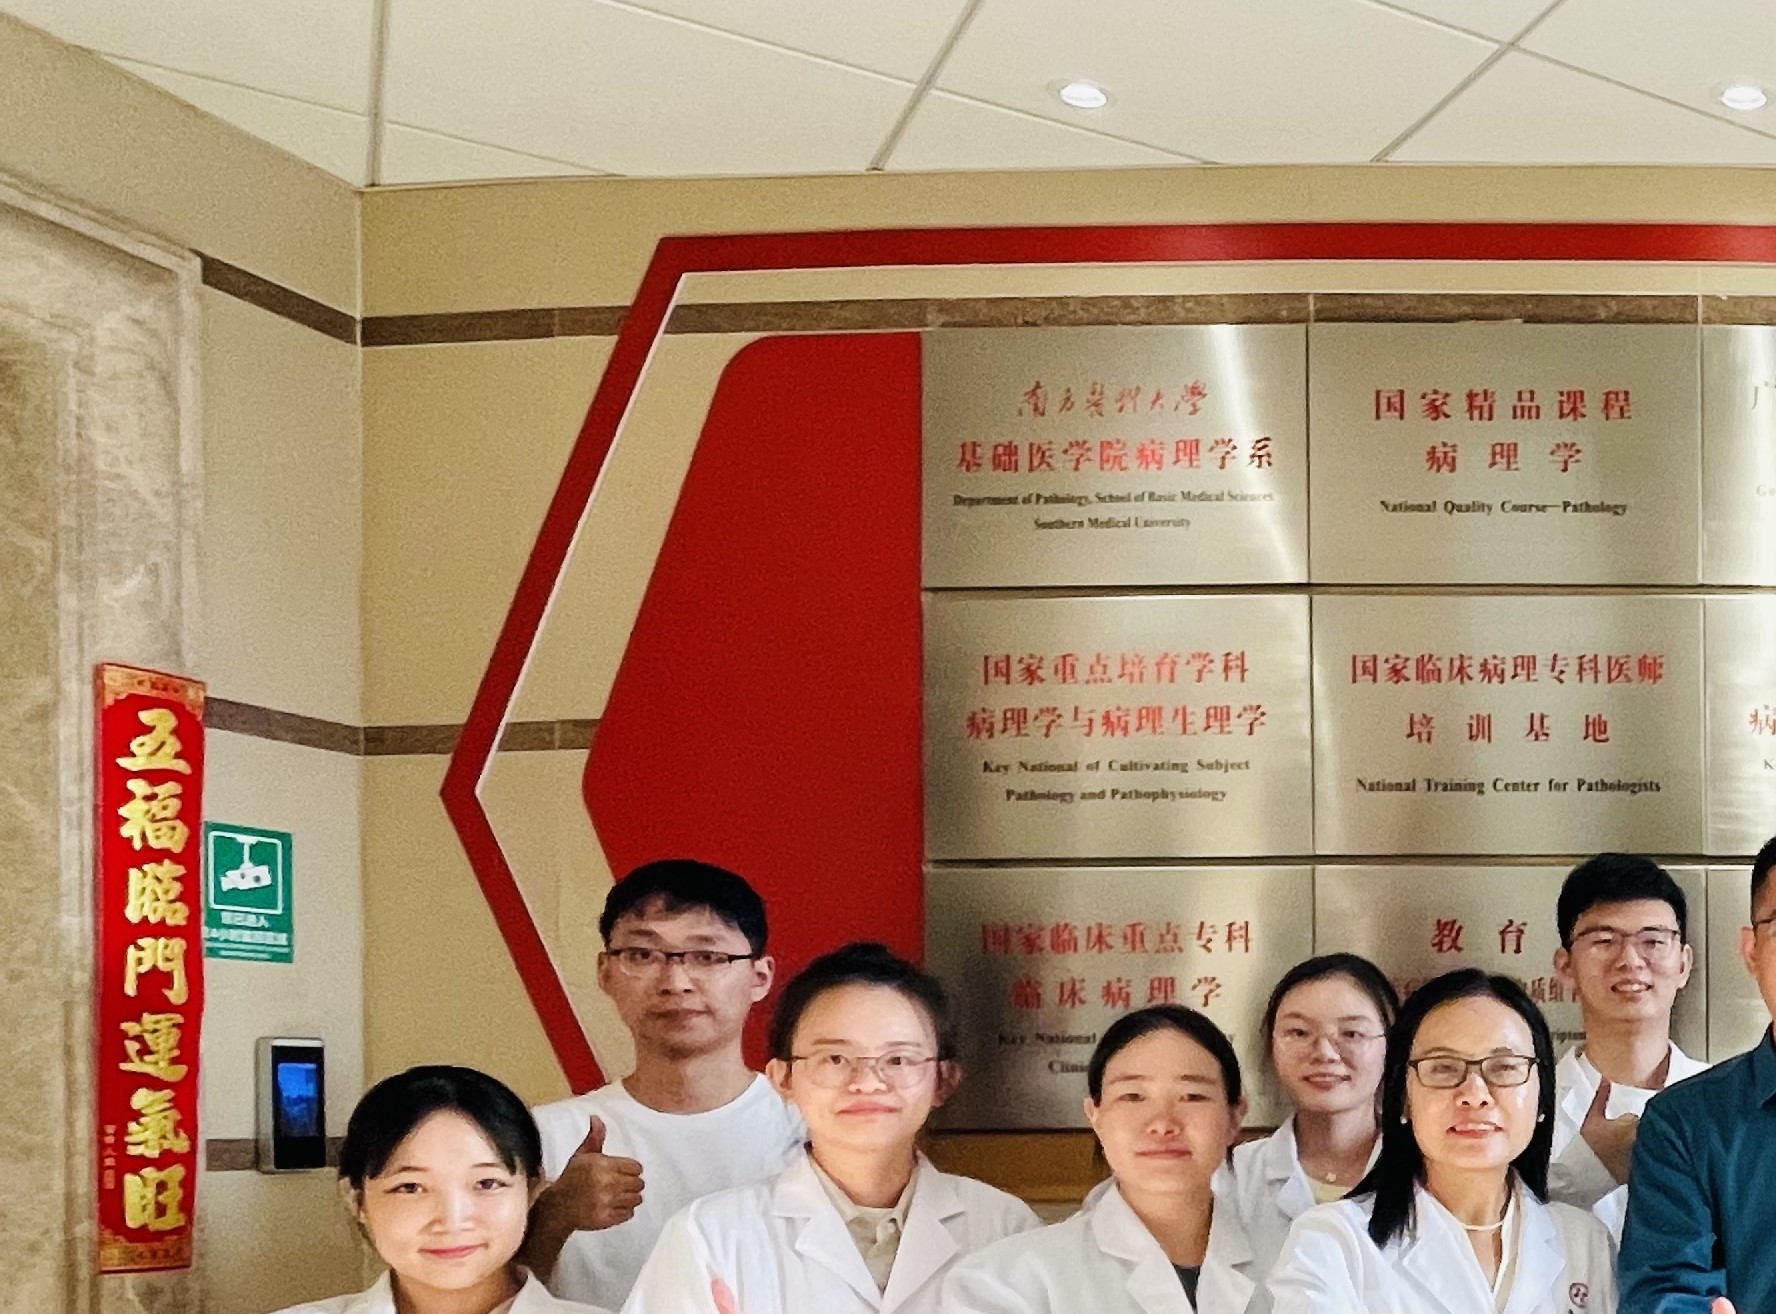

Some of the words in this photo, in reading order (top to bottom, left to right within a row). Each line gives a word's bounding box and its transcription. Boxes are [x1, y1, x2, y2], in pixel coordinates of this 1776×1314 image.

[1373, 388, 1633, 422] 国家精品课程
[956, 437, 1273, 473] 基础医学院病理学系
[1425, 441, 1583, 473] 病理学
[1134, 491, 1145, 503] of
[1180, 489, 1224, 503] Medical
[1227, 490, 1274, 503] Sciences
[1380, 500, 1437, 514] National
[1443, 500, 1493, 516] Quality
[1033, 518, 1084, 531] Southern
[1087, 517, 1131, 529] Medical
[1134, 516, 1191, 531] University
[982, 651, 1249, 686] 国家重点培育学科
[1351, 653, 1665, 685] 国家临床病理专科医师
[965, 703, 1267, 740] 病理学与病理生理学
[1405, 712, 1610, 744] 培训基地
[982, 759, 1009, 774] Key
[1018, 759, 1078, 773] National
[1086, 759, 1100, 772] of
[1108, 758, 1189, 774] Cultivating
[1196, 758, 1250, 774] Subject
[1006, 788, 1075, 804] Pathology
[1080, 787, 1105, 800] and
[1110, 788, 1227, 804] Pathophysiology
[1356, 777, 1416, 792] National
[1423, 777, 1485, 795] Training
[1492, 777, 1540, 792] Center
[1548, 777, 1569, 792] for
[1576, 777, 1661, 795] Pathologists
[981, 920, 1251, 953] 国家临床重点专科
[1431, 918, 1527, 954] 教育
[116, 708, 192, 1232] 五福臨門運氣旺
[1010, 976, 1222, 1010] 临床病理学
[1035, 1031, 1097, 1045] National
